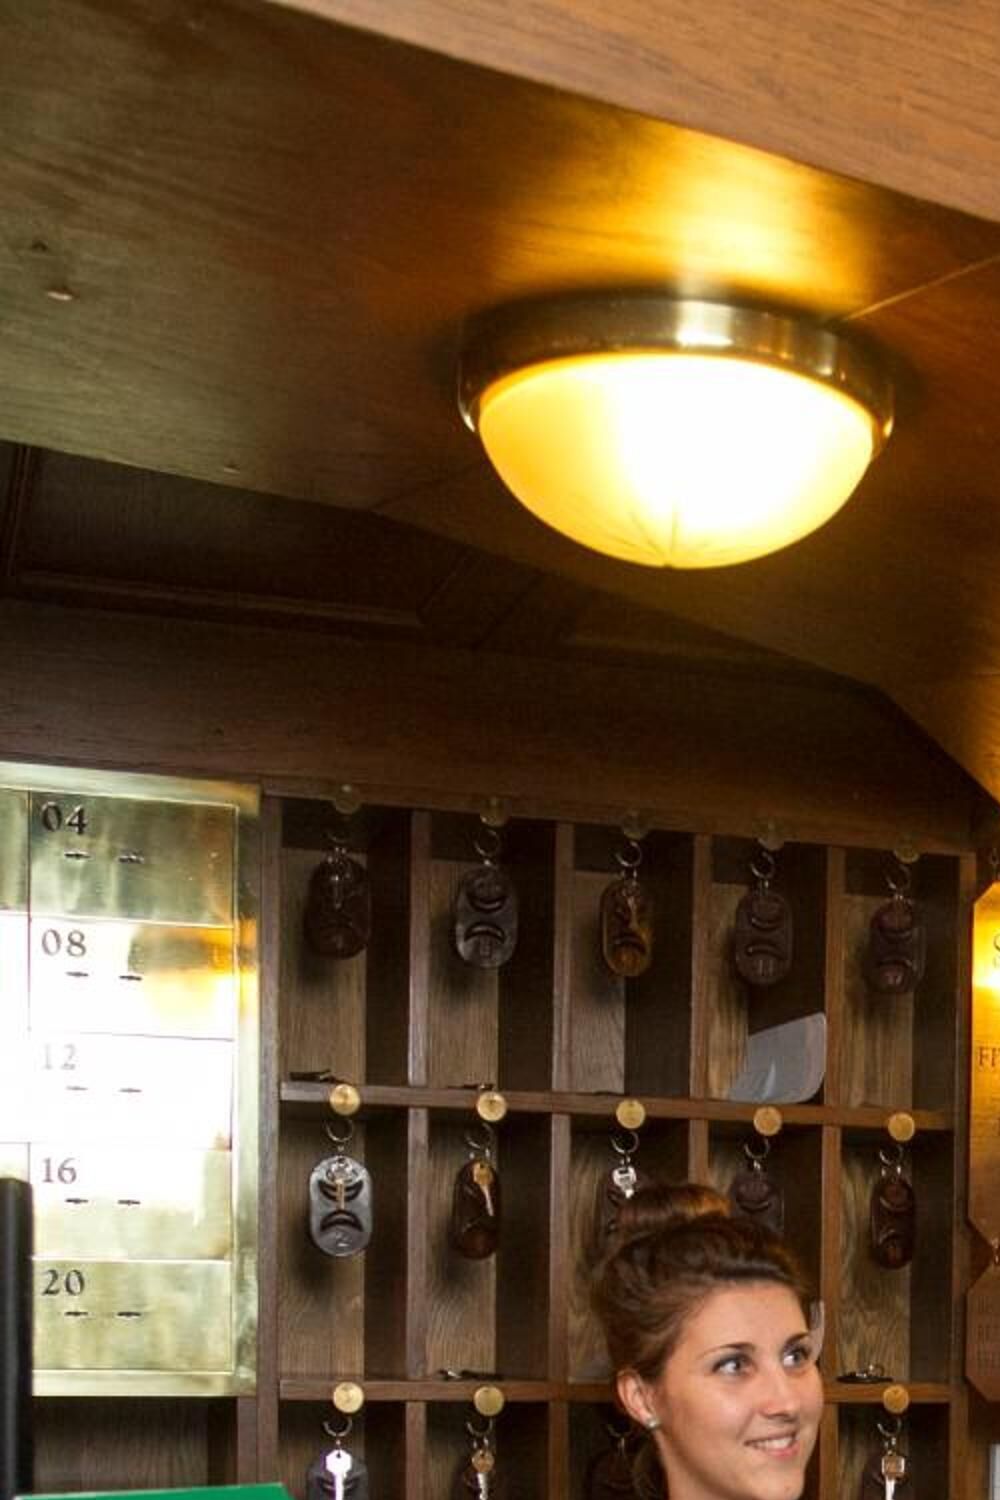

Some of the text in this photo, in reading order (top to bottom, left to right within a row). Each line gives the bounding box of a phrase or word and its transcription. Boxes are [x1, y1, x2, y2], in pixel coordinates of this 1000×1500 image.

[40, 801, 88, 836] 04
[40, 928, 88, 958] 08
[41, 1043, 77, 1070] 12
[41, 1156, 77, 1185] 16
[41, 1268, 86, 1297] 20
